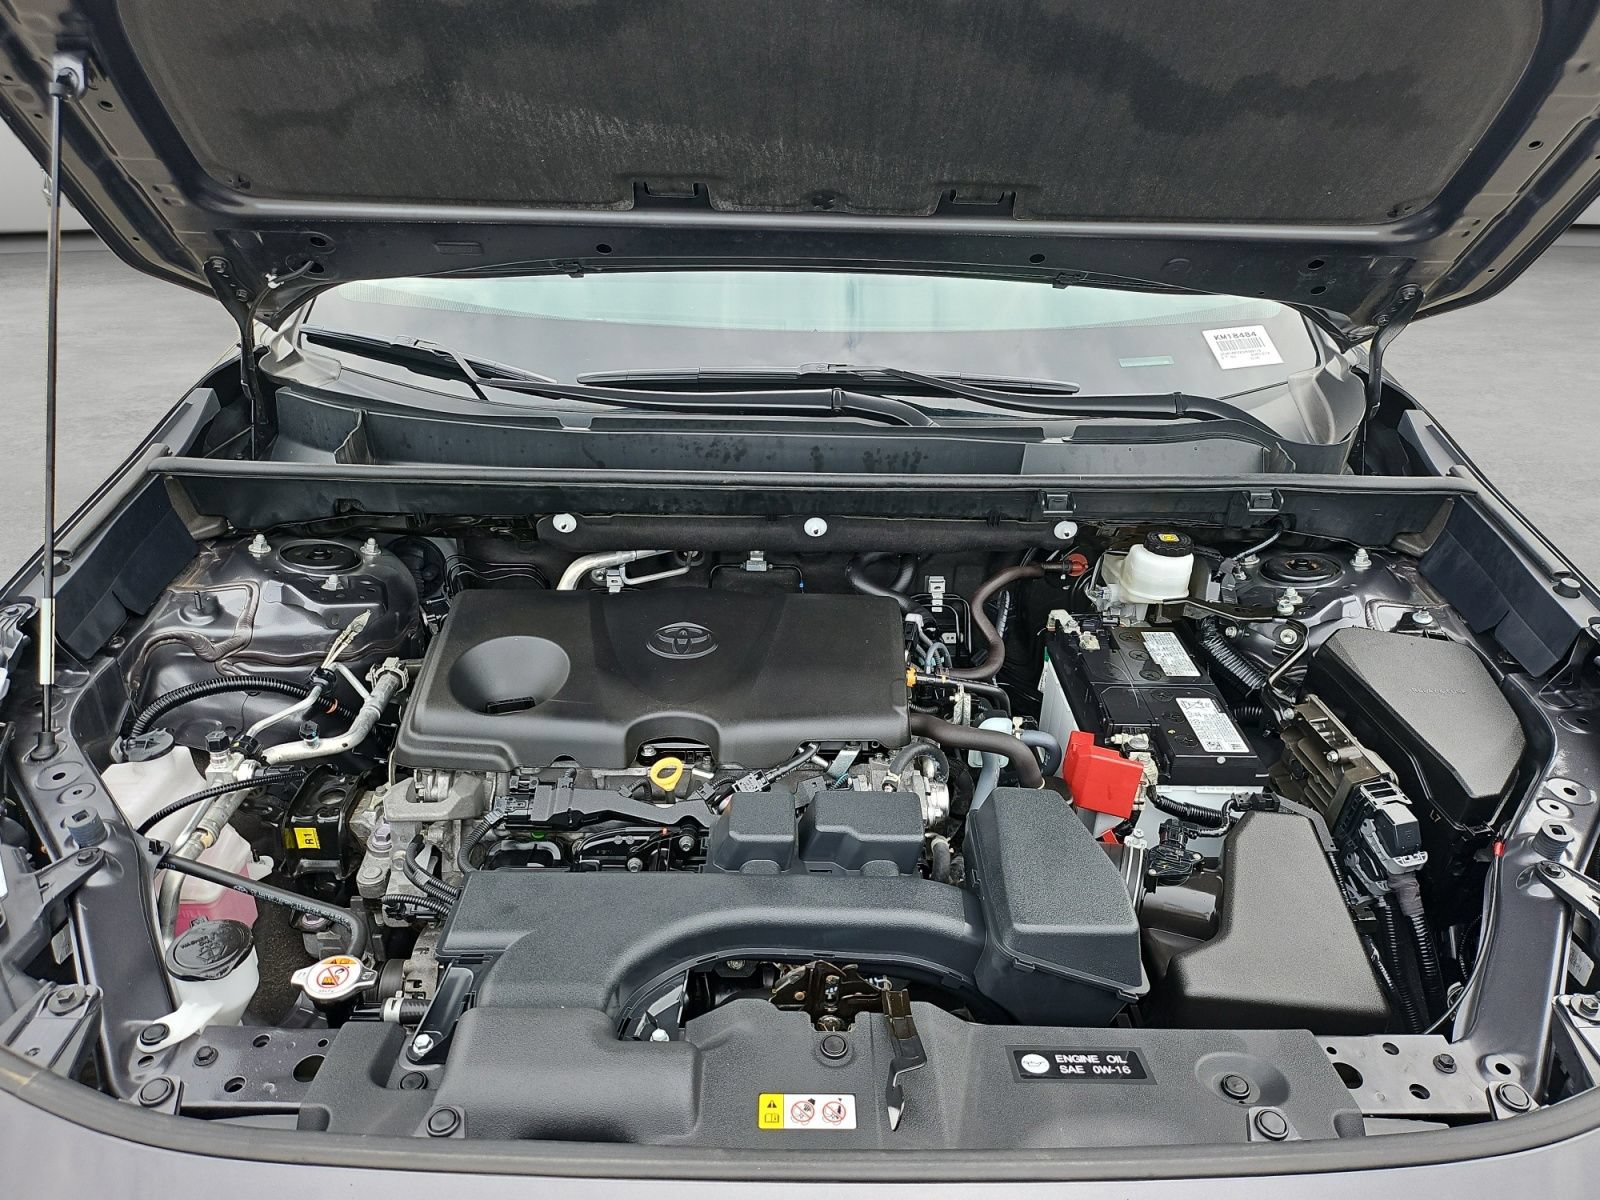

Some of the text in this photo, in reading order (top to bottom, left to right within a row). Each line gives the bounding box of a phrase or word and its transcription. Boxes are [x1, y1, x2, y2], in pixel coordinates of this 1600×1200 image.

[304, 833, 315, 844] R1
[1054, 1054, 1128, 1064] ENGINE OIL
[1059, 1065, 1132, 1075] SAE 0W-16
